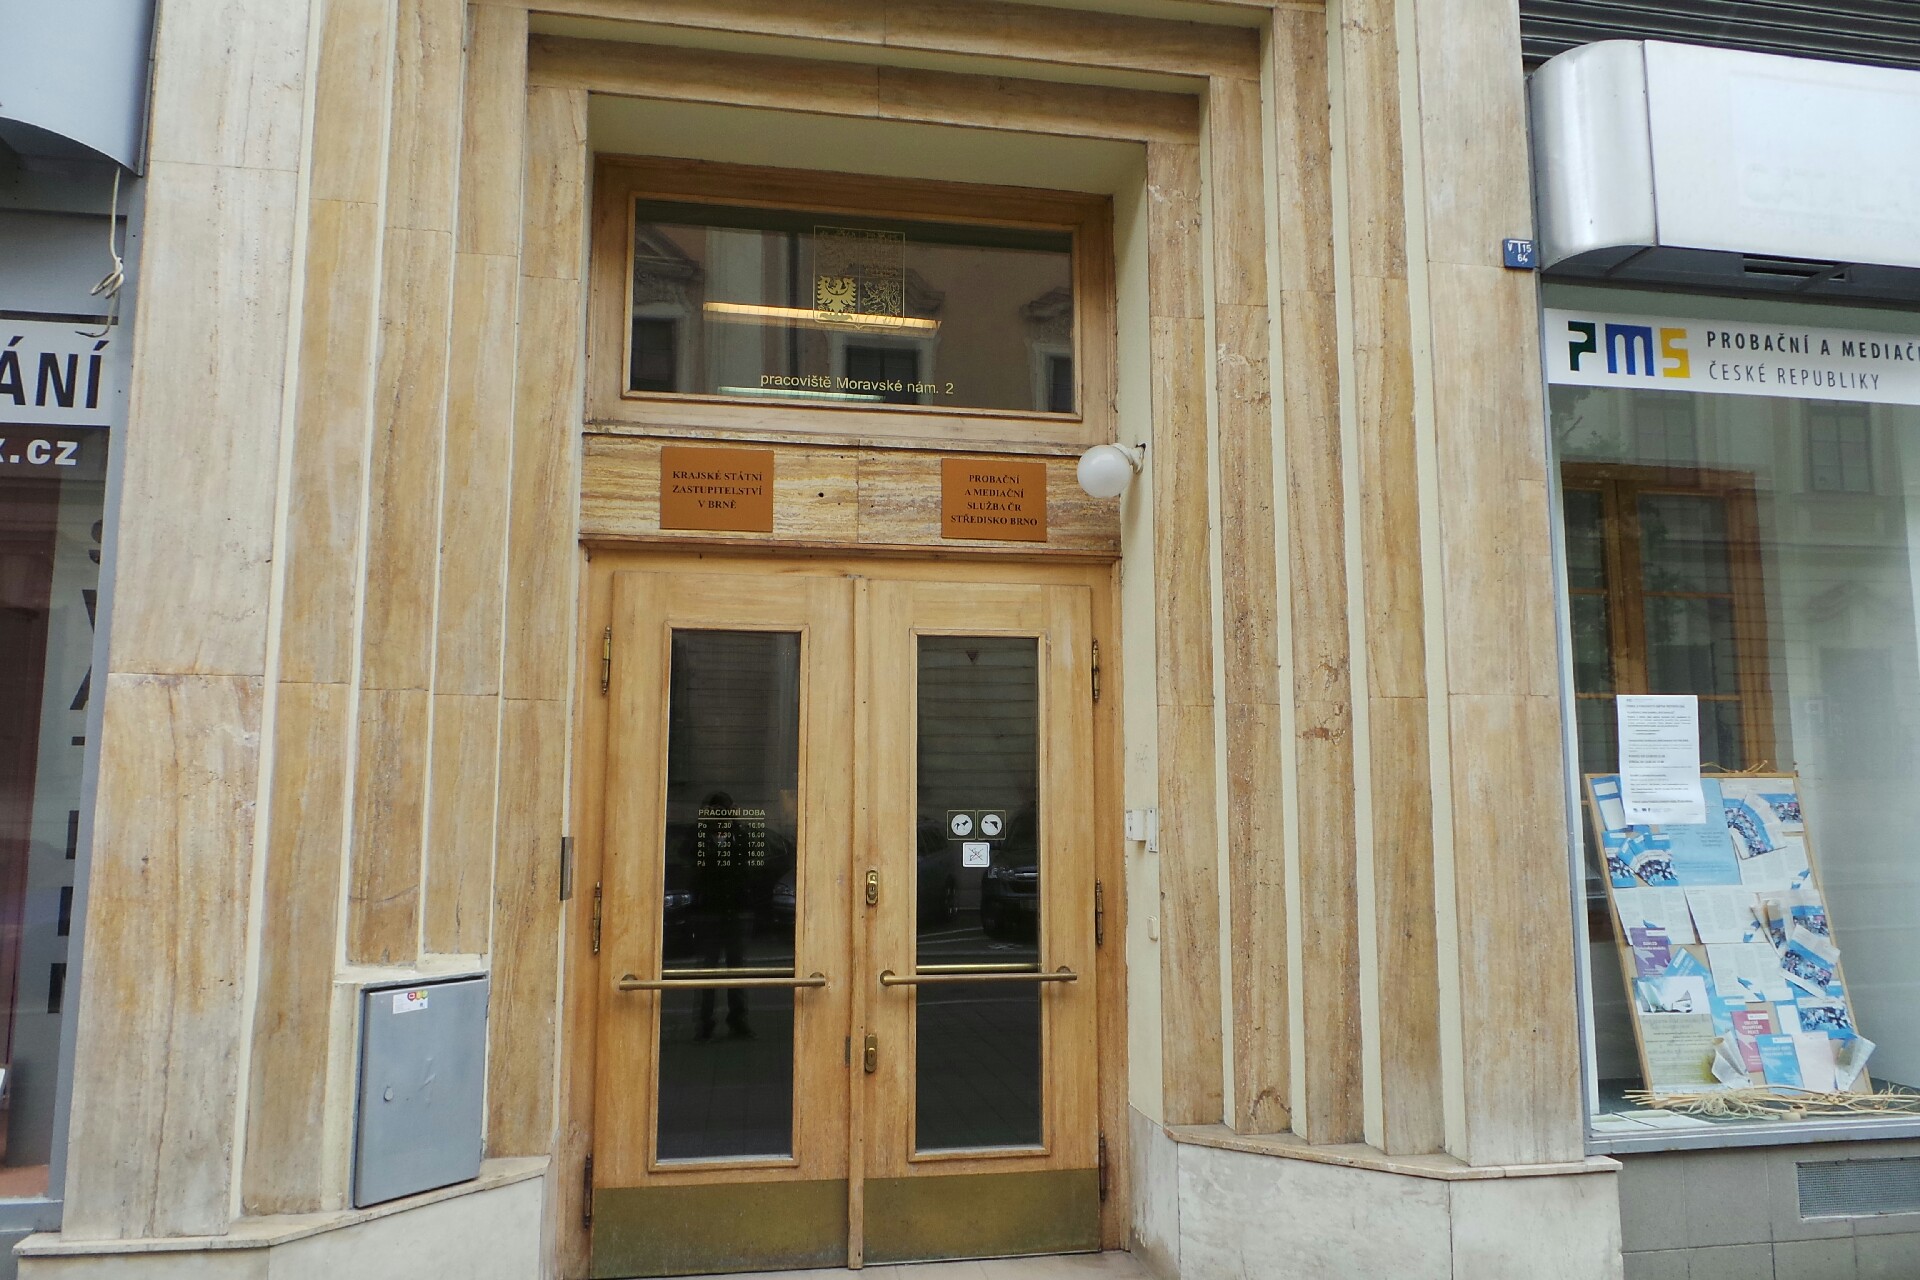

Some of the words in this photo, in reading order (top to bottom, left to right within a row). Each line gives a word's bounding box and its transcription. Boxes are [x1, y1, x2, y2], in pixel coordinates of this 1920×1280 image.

[1706, 331, 1808, 354] PROBAČNÍ
[1820, 339, 1830, 356] A
[1709, 360, 1766, 383] ČESKÉ
[1778, 367, 1880, 390] REPUBLIKY
[760, 374, 832, 388] pracoviště
[836, 377, 903, 392] Moravské
[908, 381, 939, 394] nám.
[945, 382, 954, 394] 2
[672, 470, 721, 480] KRAJSKÉ
[724, 471, 762, 482] STÁTNÍ
[969, 474, 1020, 484] PROBAČNÍ
[672, 485, 762, 496] ZASTUPITELSTVÍ
[974, 488, 1024, 498] MEDIAČNÍ
[698, 500, 706, 508] V
[708, 500, 736, 509] BRNĚ
[967, 501, 1005, 511] SLUŽBA
[1008, 502, 1022, 512] ČR
[950, 514, 1008, 525] STŘEDISKO
[1010, 517, 1038, 526] BRNO
[698, 808, 740, 816] PRACOVNÍ
